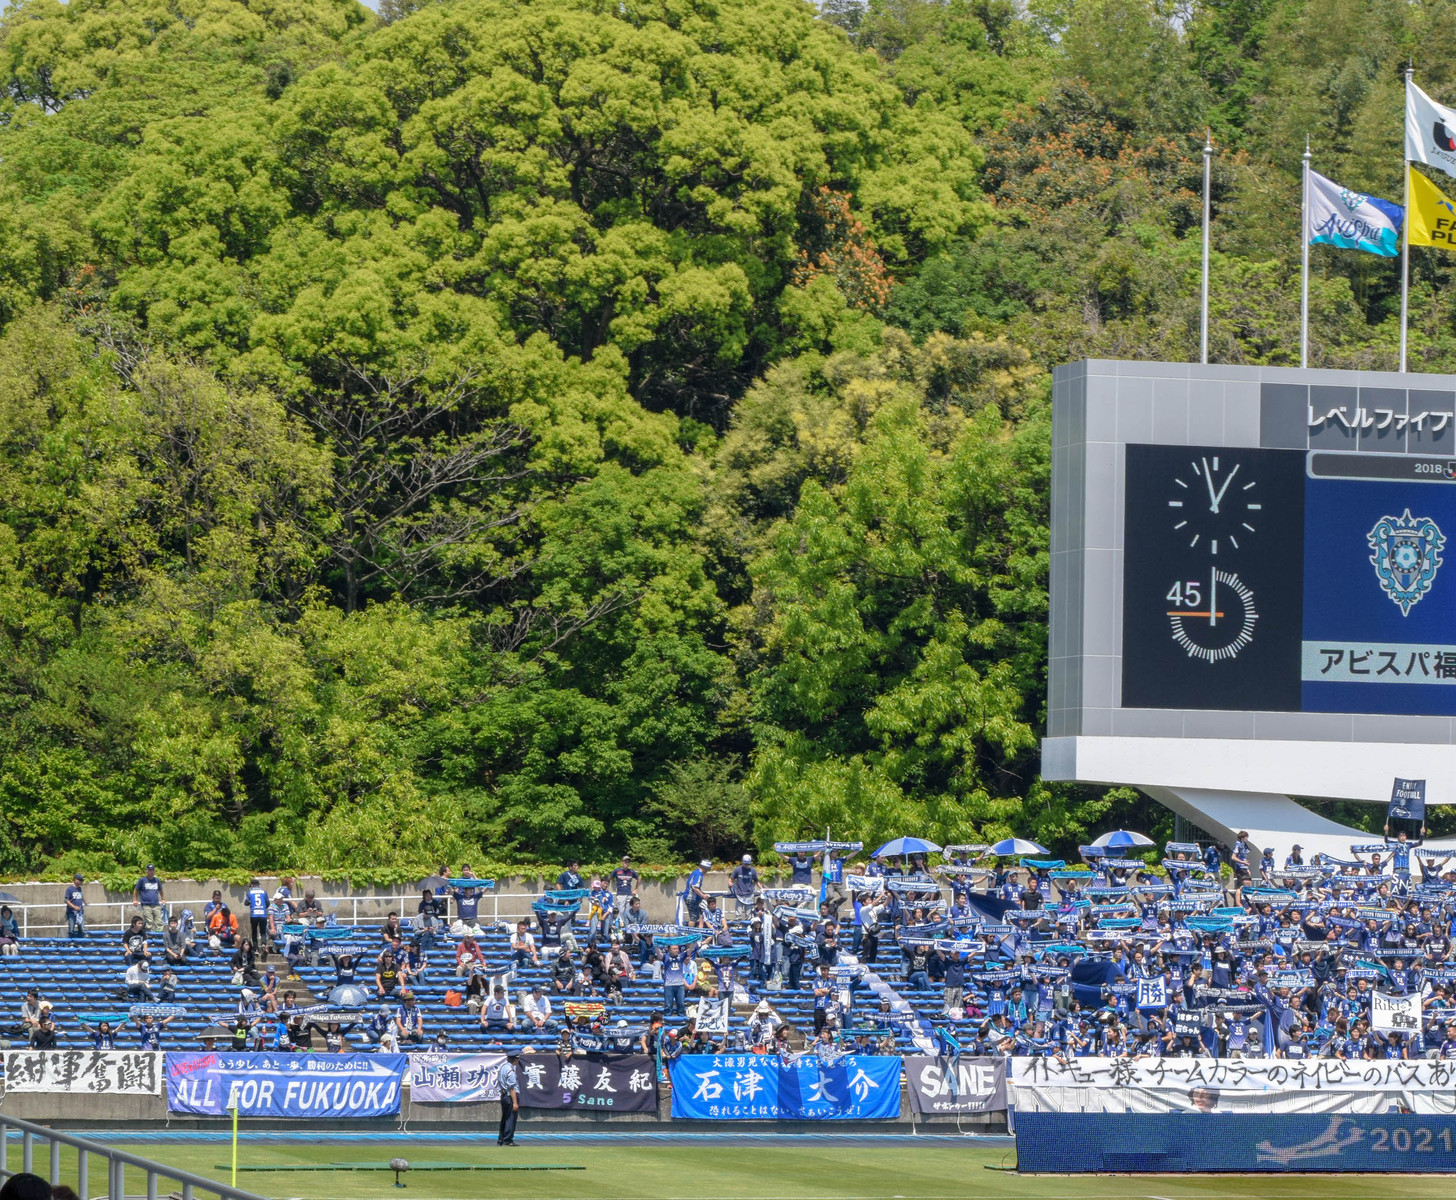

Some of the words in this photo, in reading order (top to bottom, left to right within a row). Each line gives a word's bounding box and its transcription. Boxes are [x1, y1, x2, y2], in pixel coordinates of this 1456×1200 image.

[1308, 405, 1453, 432] レベルファイブ
[1414, 463, 1442, 474] 2018
[1166, 581, 1201, 607] 45
[1139, 982, 1164, 1004] 勝
[692, 1068, 764, 1102] 石津
[807, 1068, 879, 1103] 大介
[920, 1062, 996, 1098] SANE
[174, 1078, 216, 1107] ALL
[227, 1080, 274, 1109] FOR
[284, 1081, 397, 1110] FUKUOKA
[562, 1092, 571, 1103] 5
[577, 1094, 614, 1106] Sane
